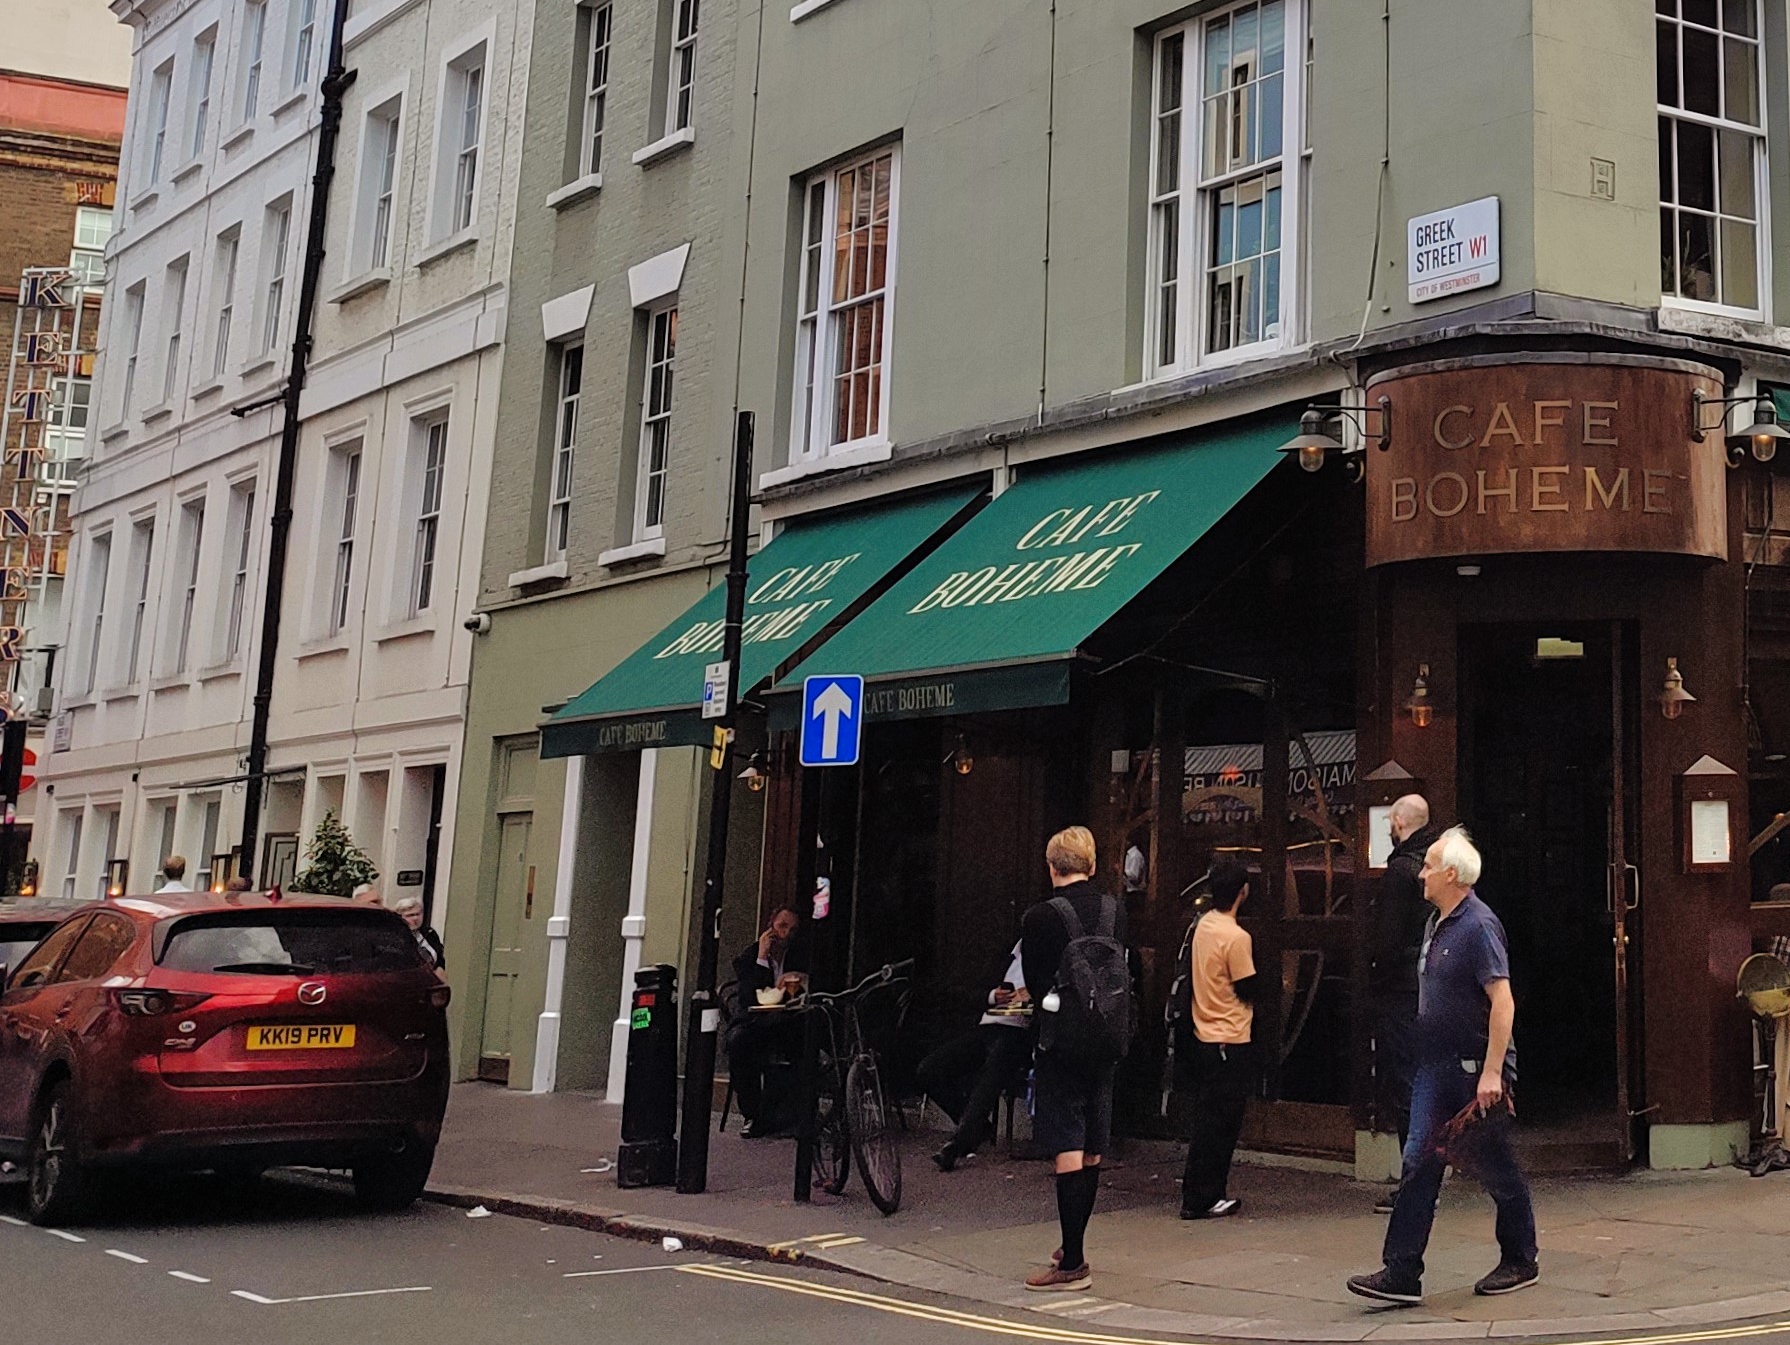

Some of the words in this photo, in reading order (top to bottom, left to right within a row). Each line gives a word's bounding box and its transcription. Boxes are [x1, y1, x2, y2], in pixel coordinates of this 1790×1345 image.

[1416, 217, 1456, 248] GREEK
[1416, 241, 1464, 273] STREET
[1469, 234, 1487, 259] W1
[1416, 286, 1429, 298] CITY
[1430, 283, 1438, 294] OF
[1439, 272, 1481, 291] WESTMINSTER
[1433, 399, 1620, 451] CAFE
[1391, 464, 1674, 523] BOHEME
[1015, 489, 1163, 551] CAFE
[748, 552, 863, 605] CAFE
[905, 542, 1143, 615] BOHEME
[863, 690, 895, 715] CAFE
[898, 683, 955, 711] BOHEME
[625, 720, 667, 744] BOHEME
[259, 1027, 303, 1045] KK19
[307, 1026, 344, 1044] PRV
